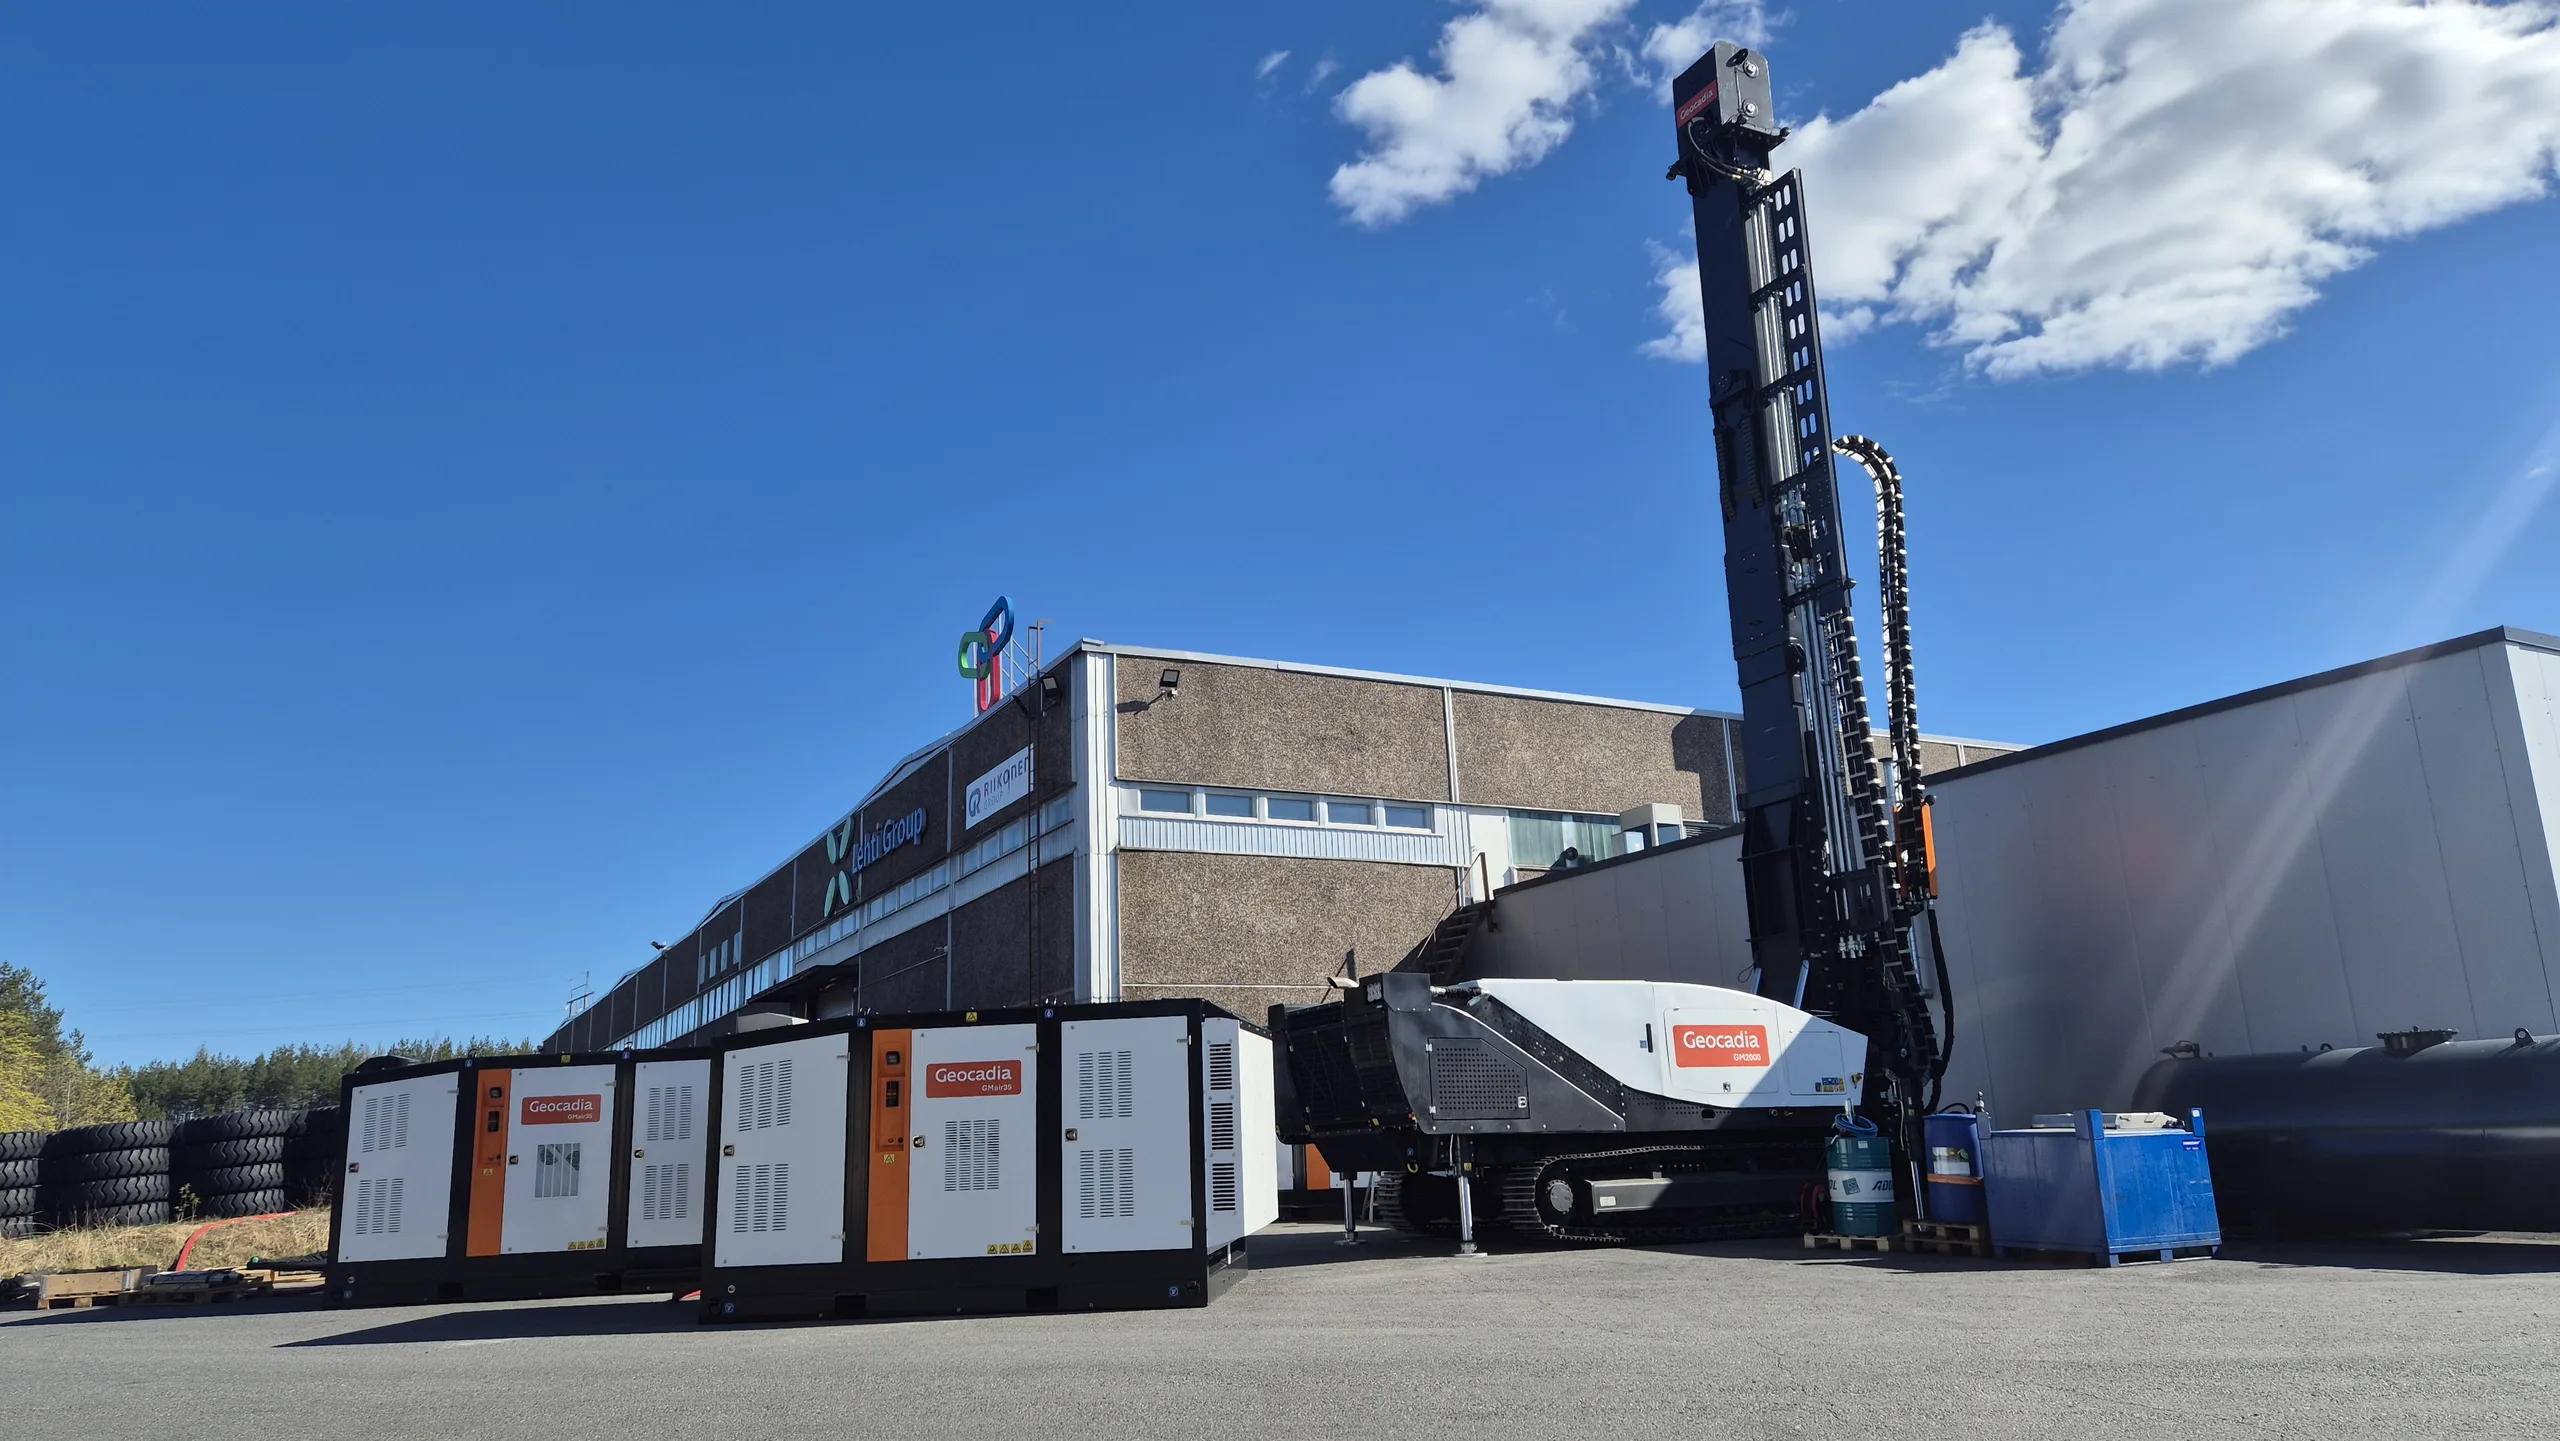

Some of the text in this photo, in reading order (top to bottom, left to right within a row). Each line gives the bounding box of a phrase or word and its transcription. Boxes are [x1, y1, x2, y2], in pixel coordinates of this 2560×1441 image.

[1680, 90, 1714, 120] Geocadia
[852, 808, 926, 875] Lehti Group
[1683, 1030, 1760, 1048] Geocadia
[1733, 1053, 1762, 1062] GM2000
[935, 1065, 1012, 1083] Geocadia
[981, 1084, 1013, 1092] GMair35
[529, 1098, 594, 1113] Geocadia
